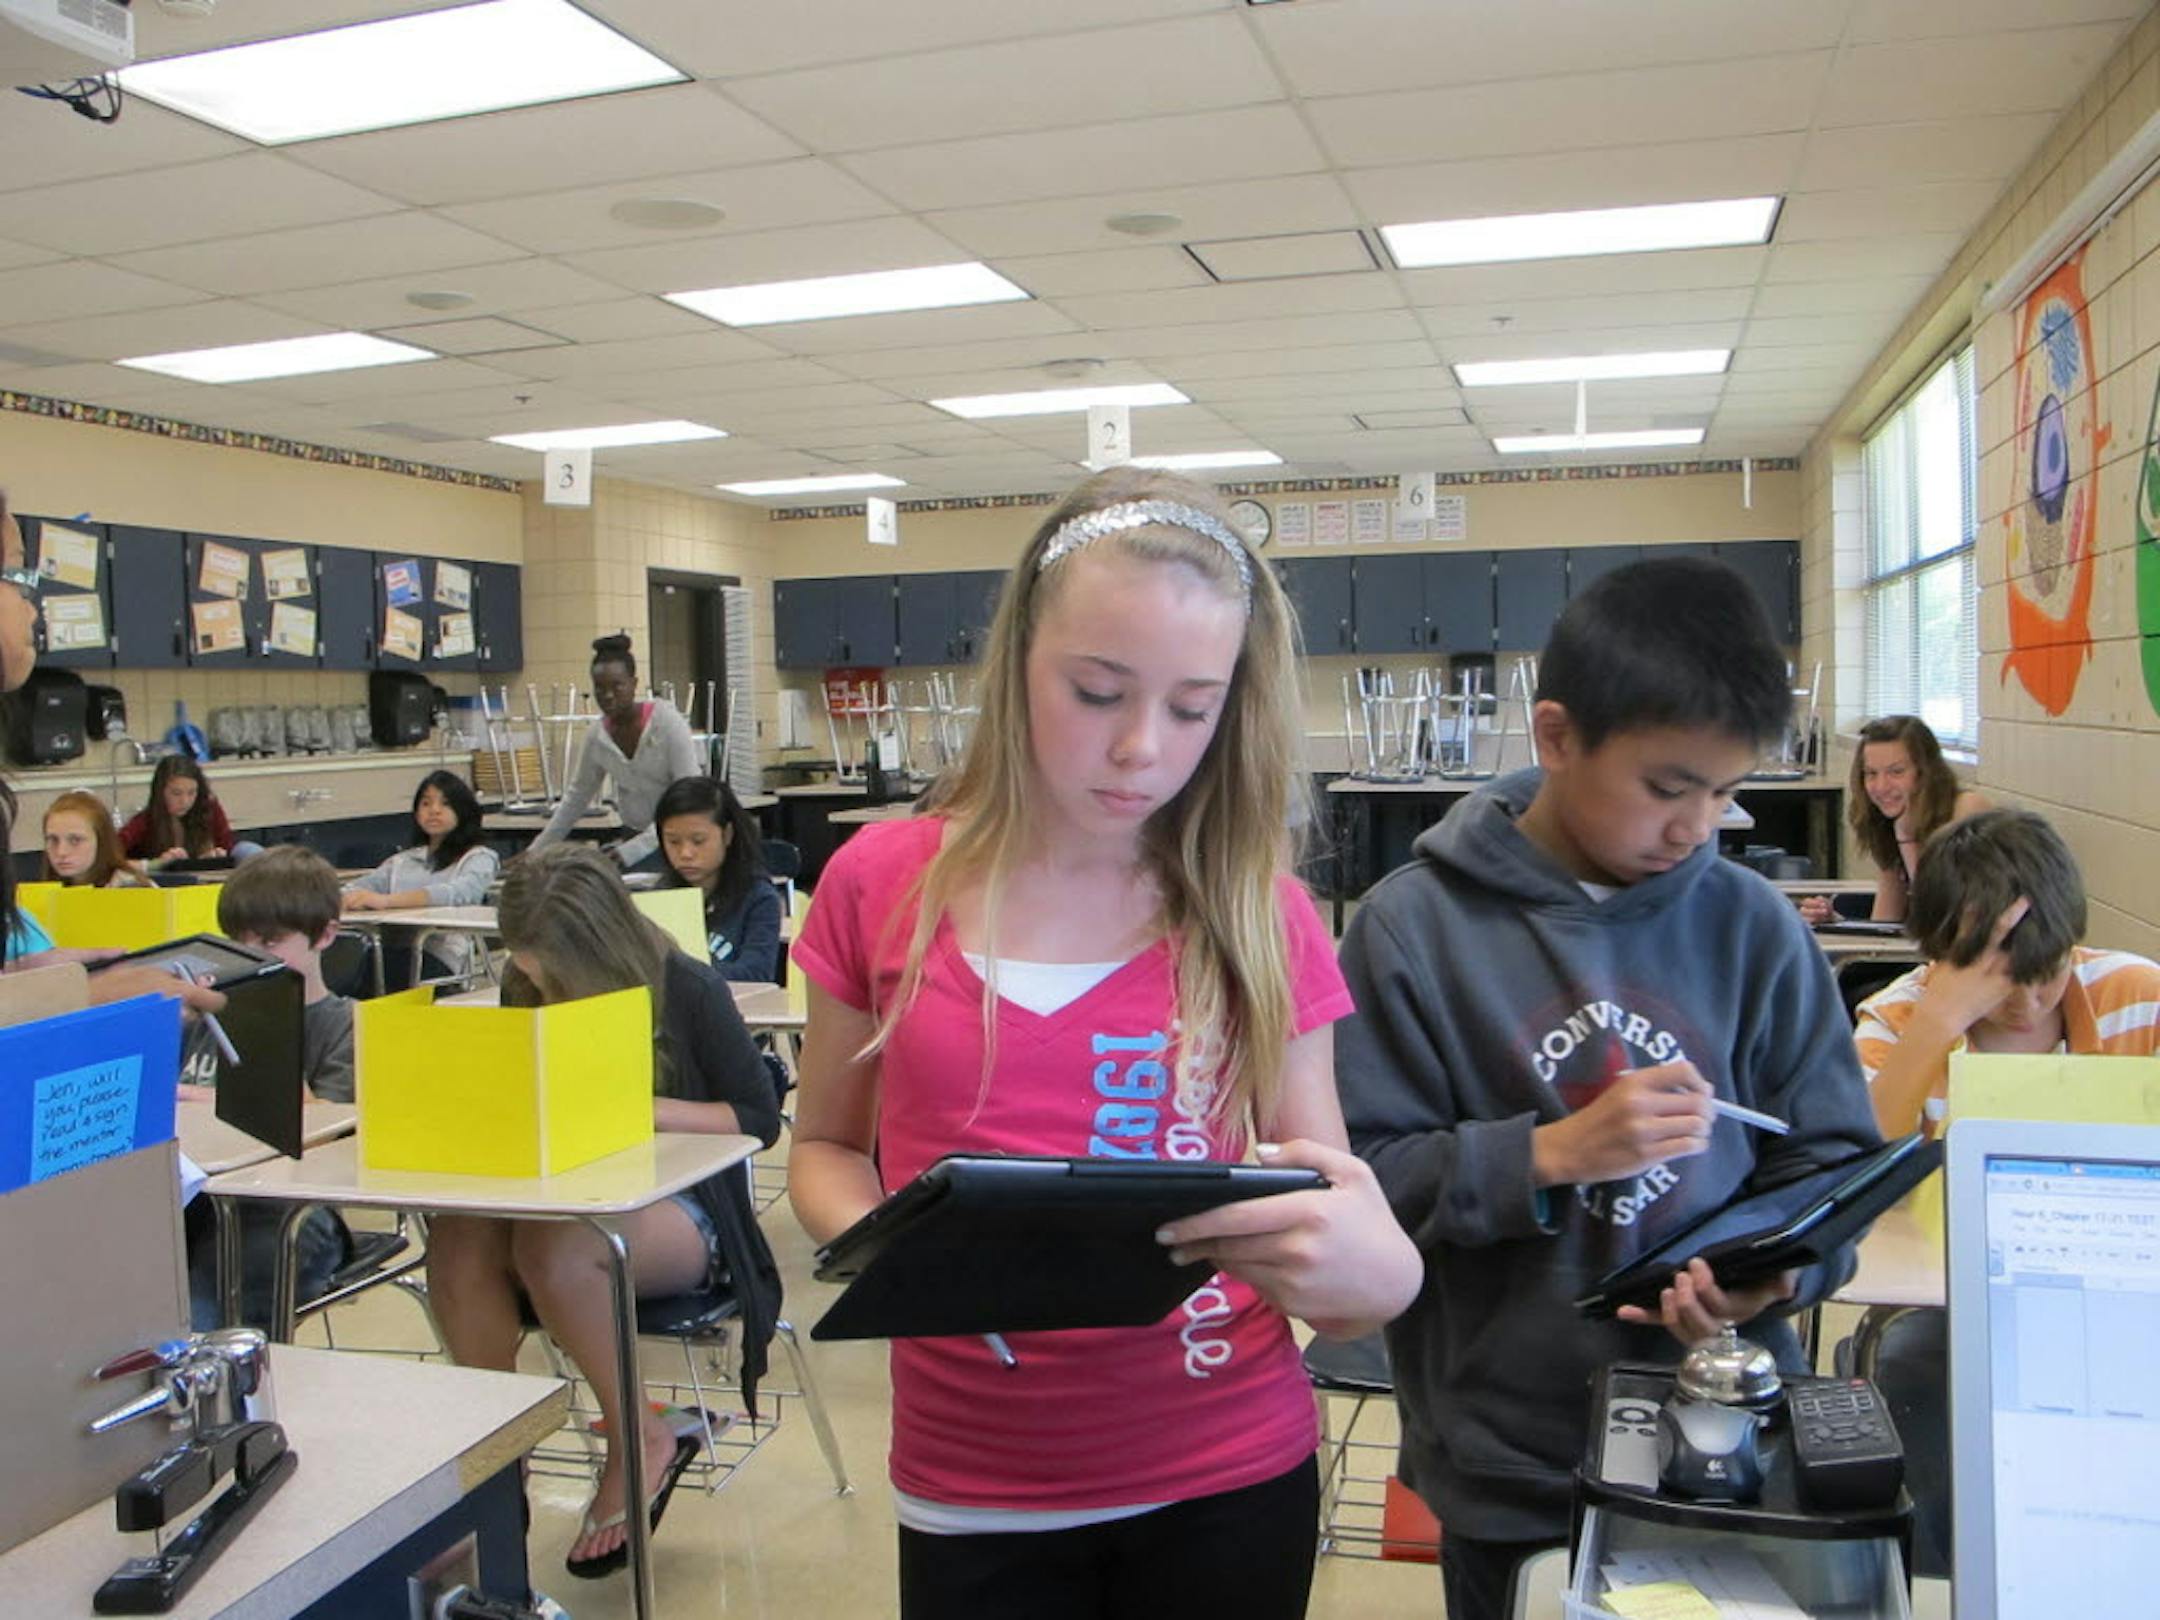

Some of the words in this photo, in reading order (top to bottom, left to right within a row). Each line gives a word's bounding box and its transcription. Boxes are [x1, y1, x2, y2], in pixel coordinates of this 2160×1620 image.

[1103, 421, 1118, 450] 2
[560, 463, 575, 489] 3
[1409, 486, 1423, 506] 6
[44, 1103, 75, 1130] you
